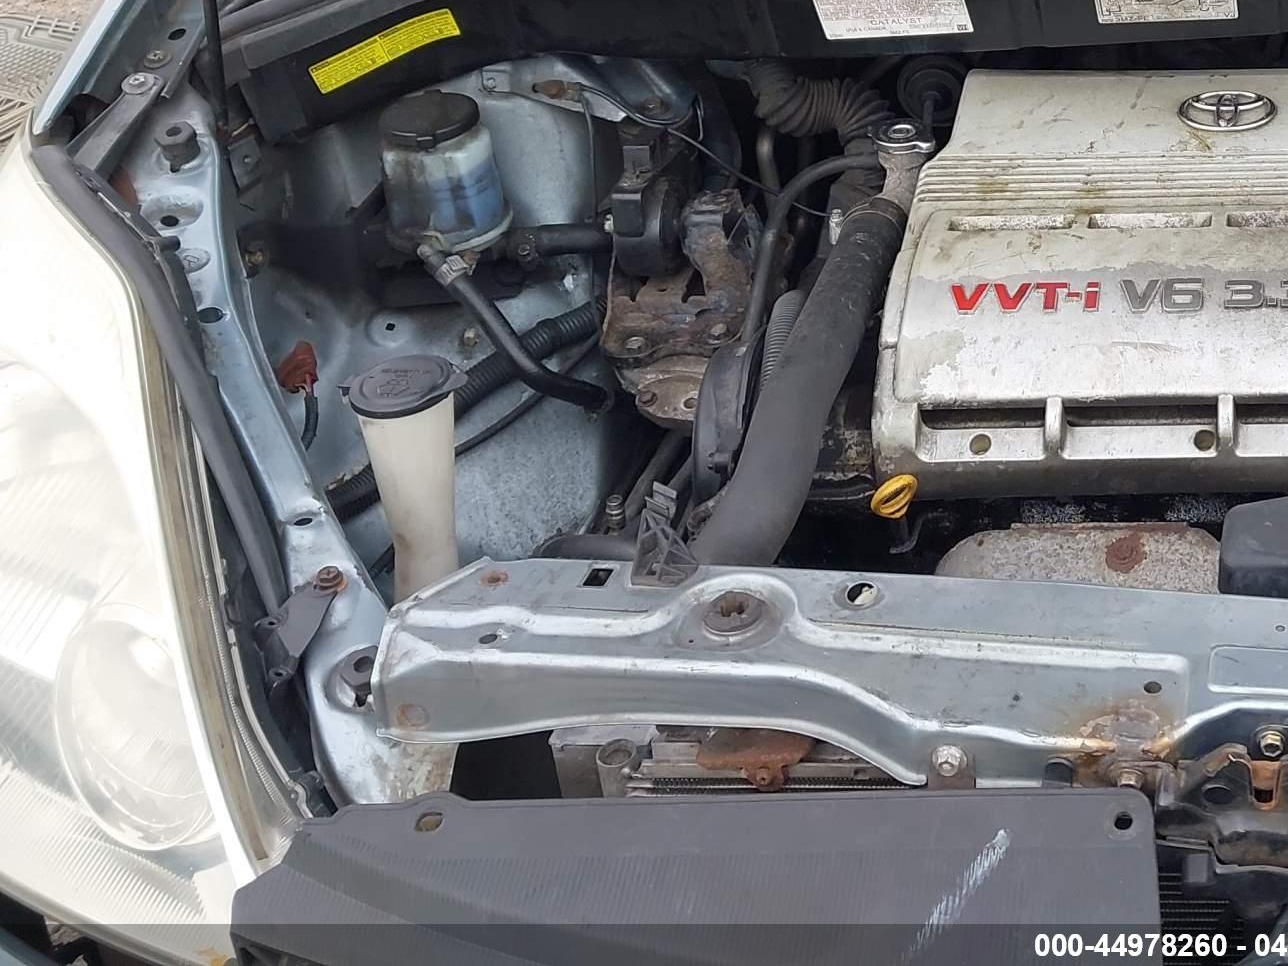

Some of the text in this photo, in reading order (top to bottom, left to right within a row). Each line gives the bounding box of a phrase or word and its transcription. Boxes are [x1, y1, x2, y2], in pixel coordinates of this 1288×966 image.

[870, 17, 923, 26] CATALYST
[950, 282, 1100, 315] VVT-i
[1120, 278, 1204, 313] V6
